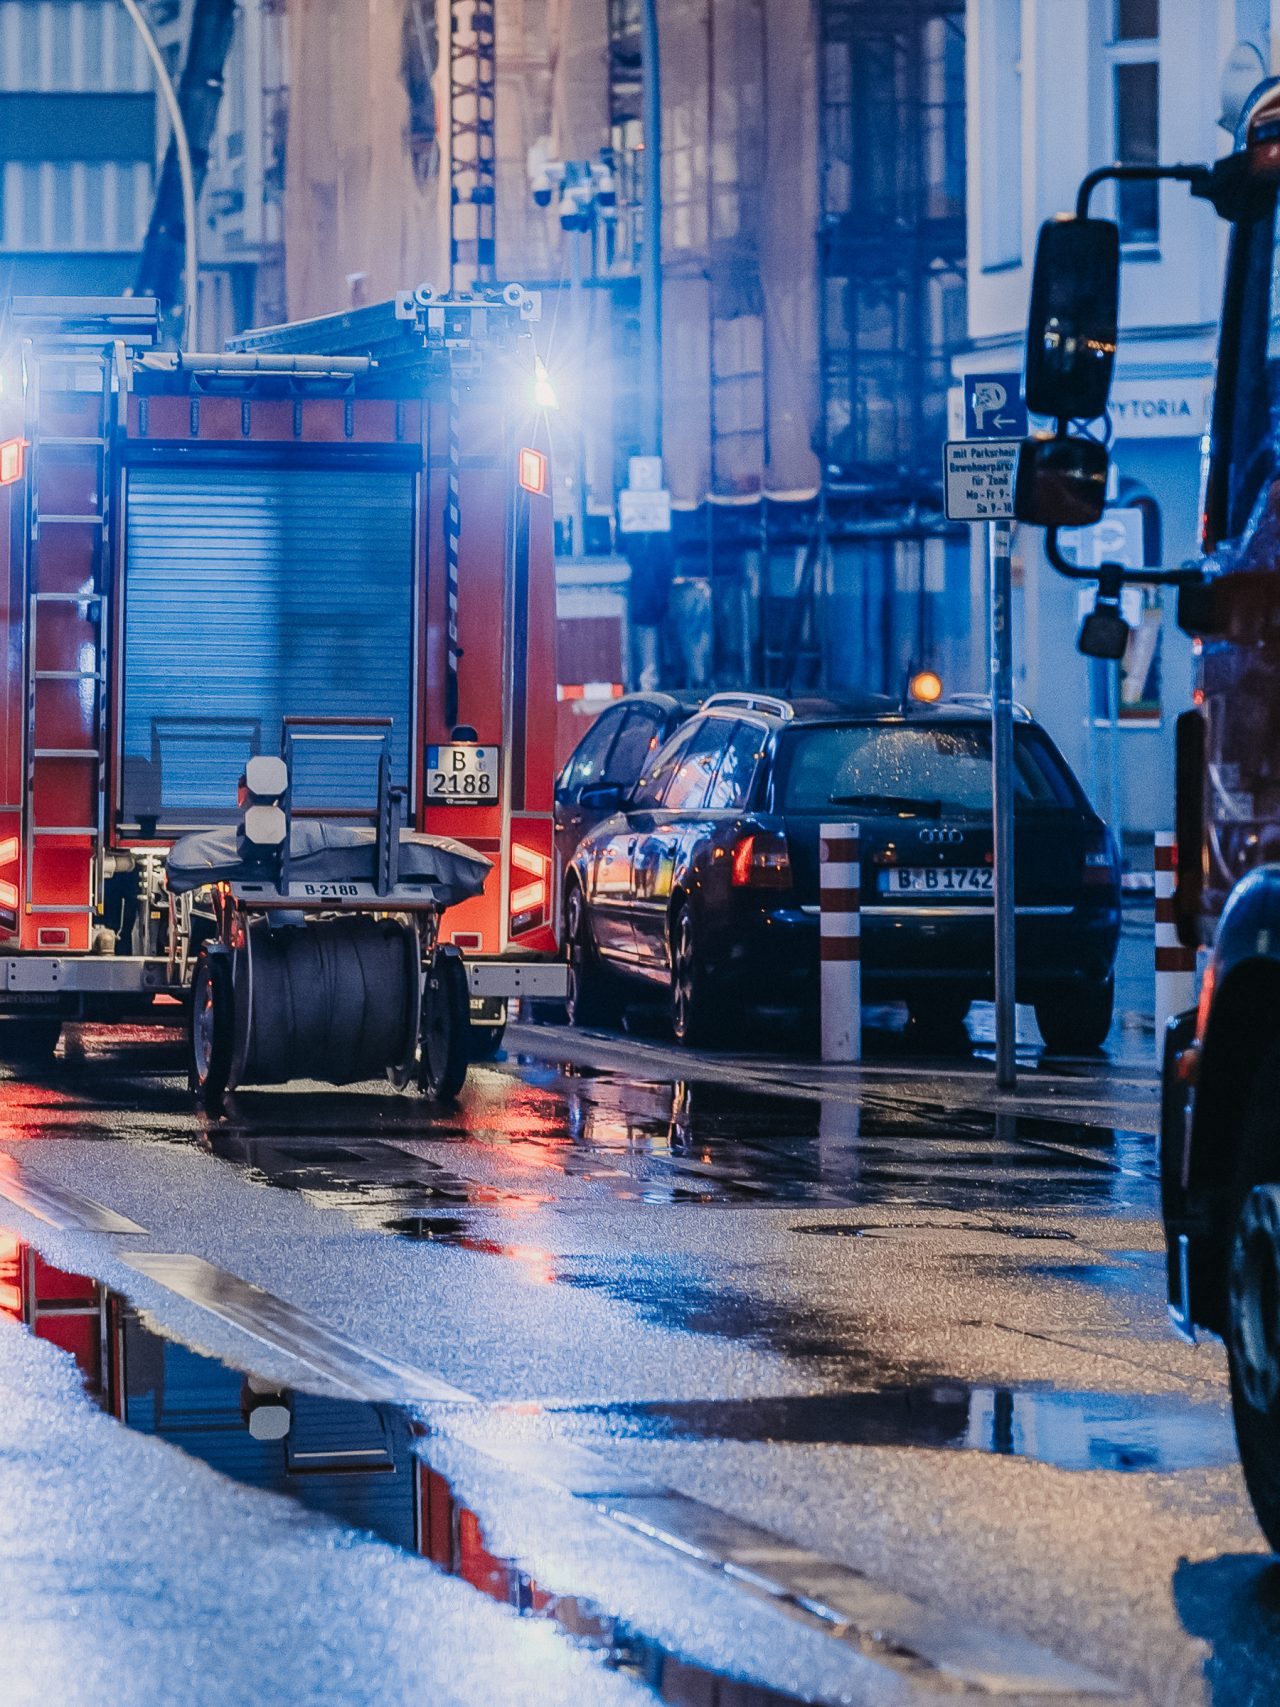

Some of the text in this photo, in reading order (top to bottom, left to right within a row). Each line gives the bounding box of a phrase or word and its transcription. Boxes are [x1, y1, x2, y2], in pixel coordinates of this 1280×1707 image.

[953, 448, 967, 458] mit
[972, 475, 984, 486] für
[452, 750, 467, 772] B
[433, 773, 491, 794] 2188
[898, 869, 912, 889] B
[304, 884, 359, 896] B-2188
